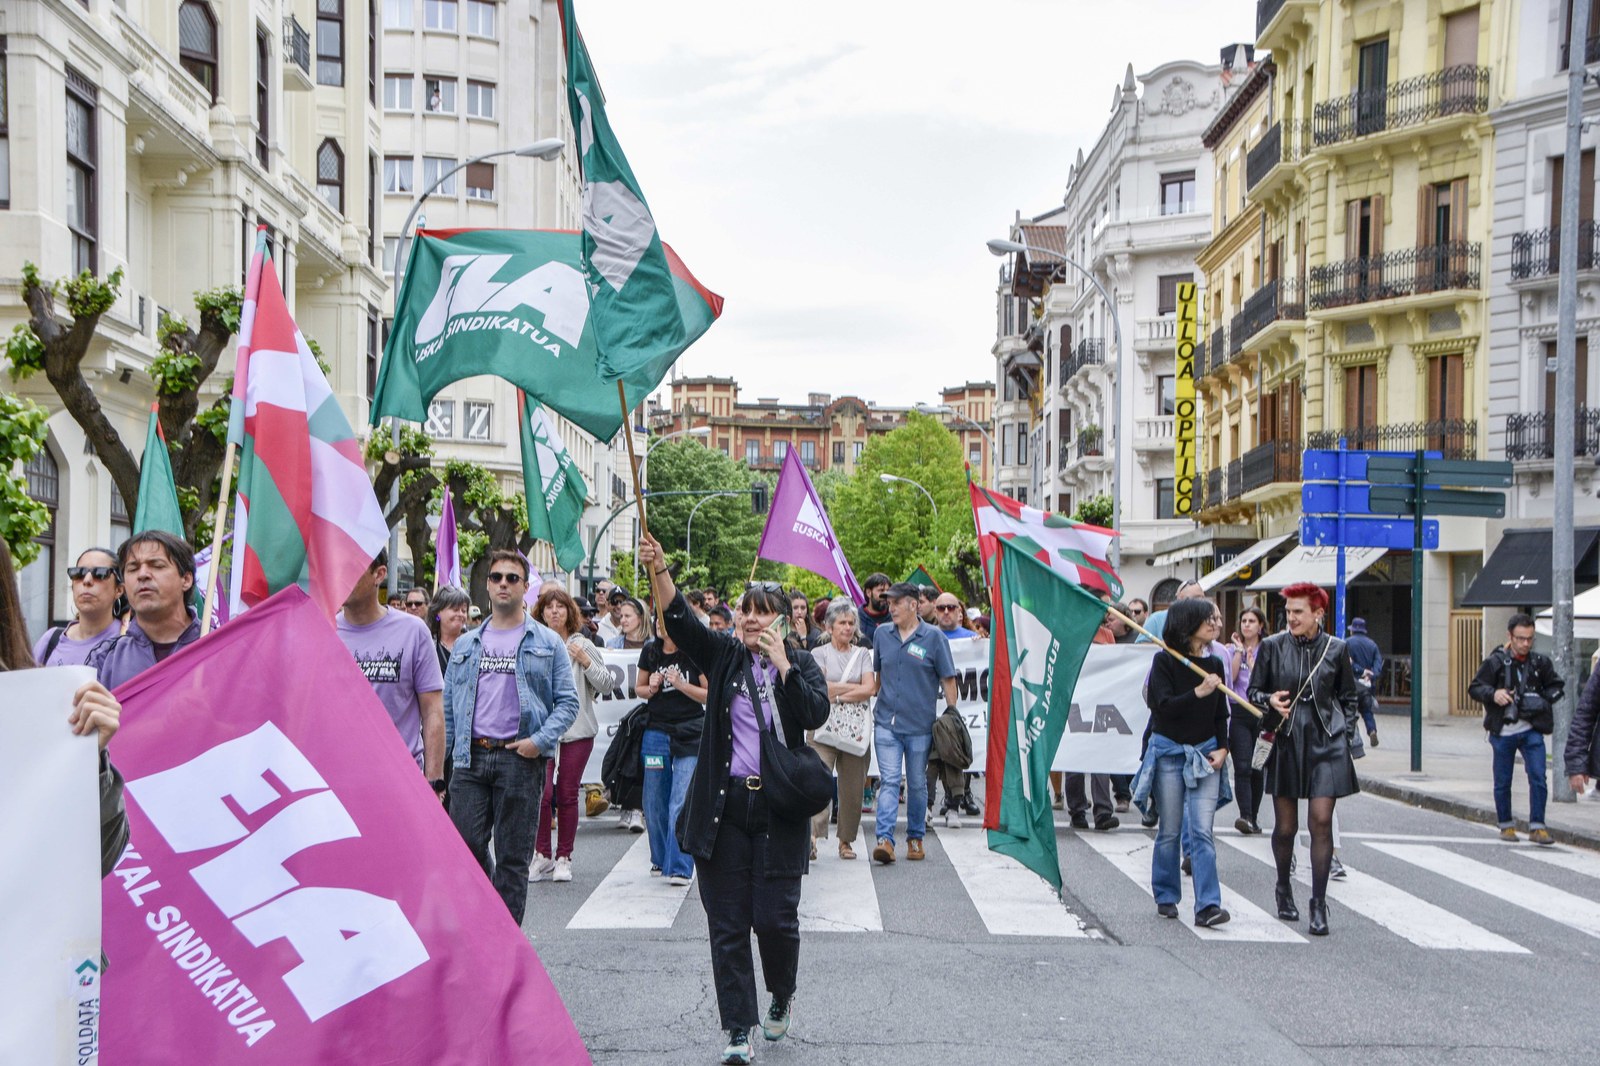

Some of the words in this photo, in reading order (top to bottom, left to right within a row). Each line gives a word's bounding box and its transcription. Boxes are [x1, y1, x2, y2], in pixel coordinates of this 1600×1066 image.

[446, 315, 561, 358] SINDIKATUA
[1178, 284, 1194, 379] ULLOA
[1176, 400, 1194, 514] OPTICO
[1066, 703, 1133, 735] LA
[125, 720, 430, 1022] ELA
[113, 843, 161, 907] KAL
[146, 905, 276, 1047] SINDIKATUA
